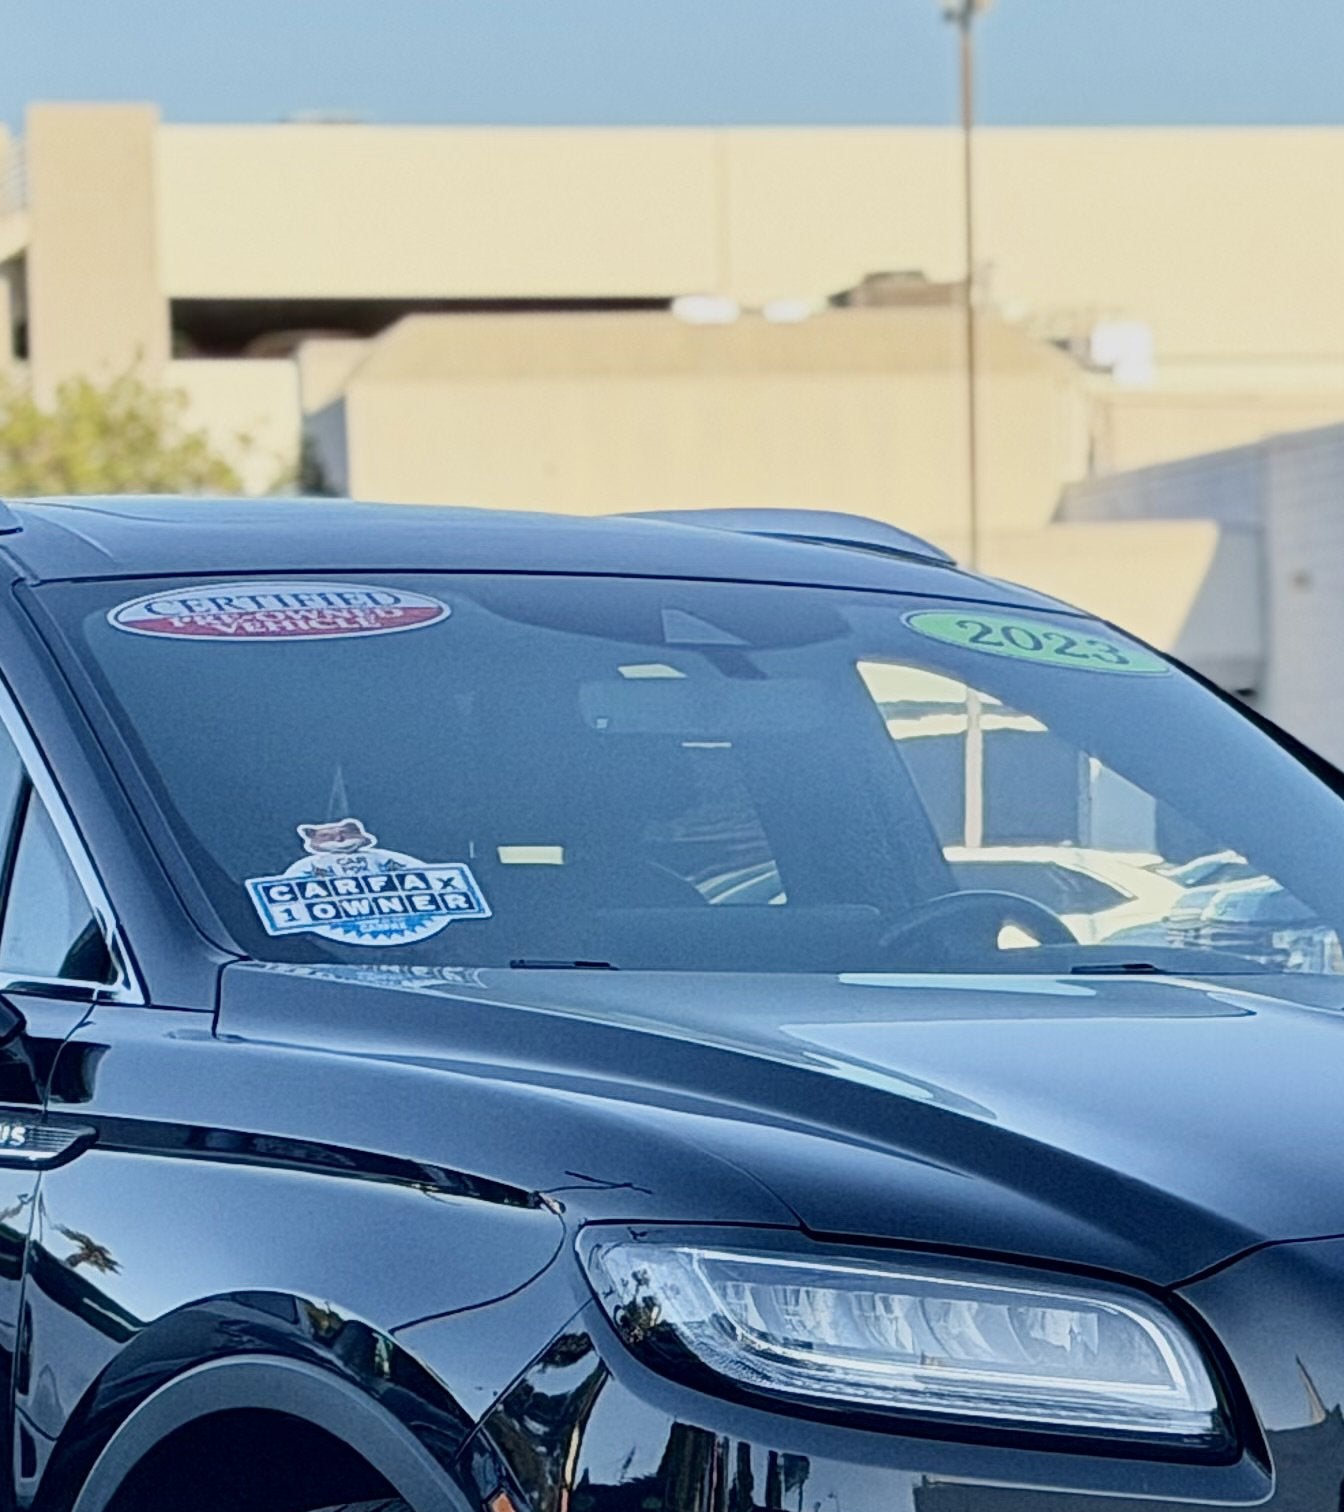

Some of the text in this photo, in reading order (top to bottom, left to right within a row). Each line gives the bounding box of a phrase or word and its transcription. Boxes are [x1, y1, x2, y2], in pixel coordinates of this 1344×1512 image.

[145, 591, 403, 616] CERTIFIED
[213, 616, 382, 634] VEHICLE
[956, 620, 1130, 665] 2023
[268, 872, 462, 902] CARFAX
[280, 893, 471, 922] 1 OWNER
